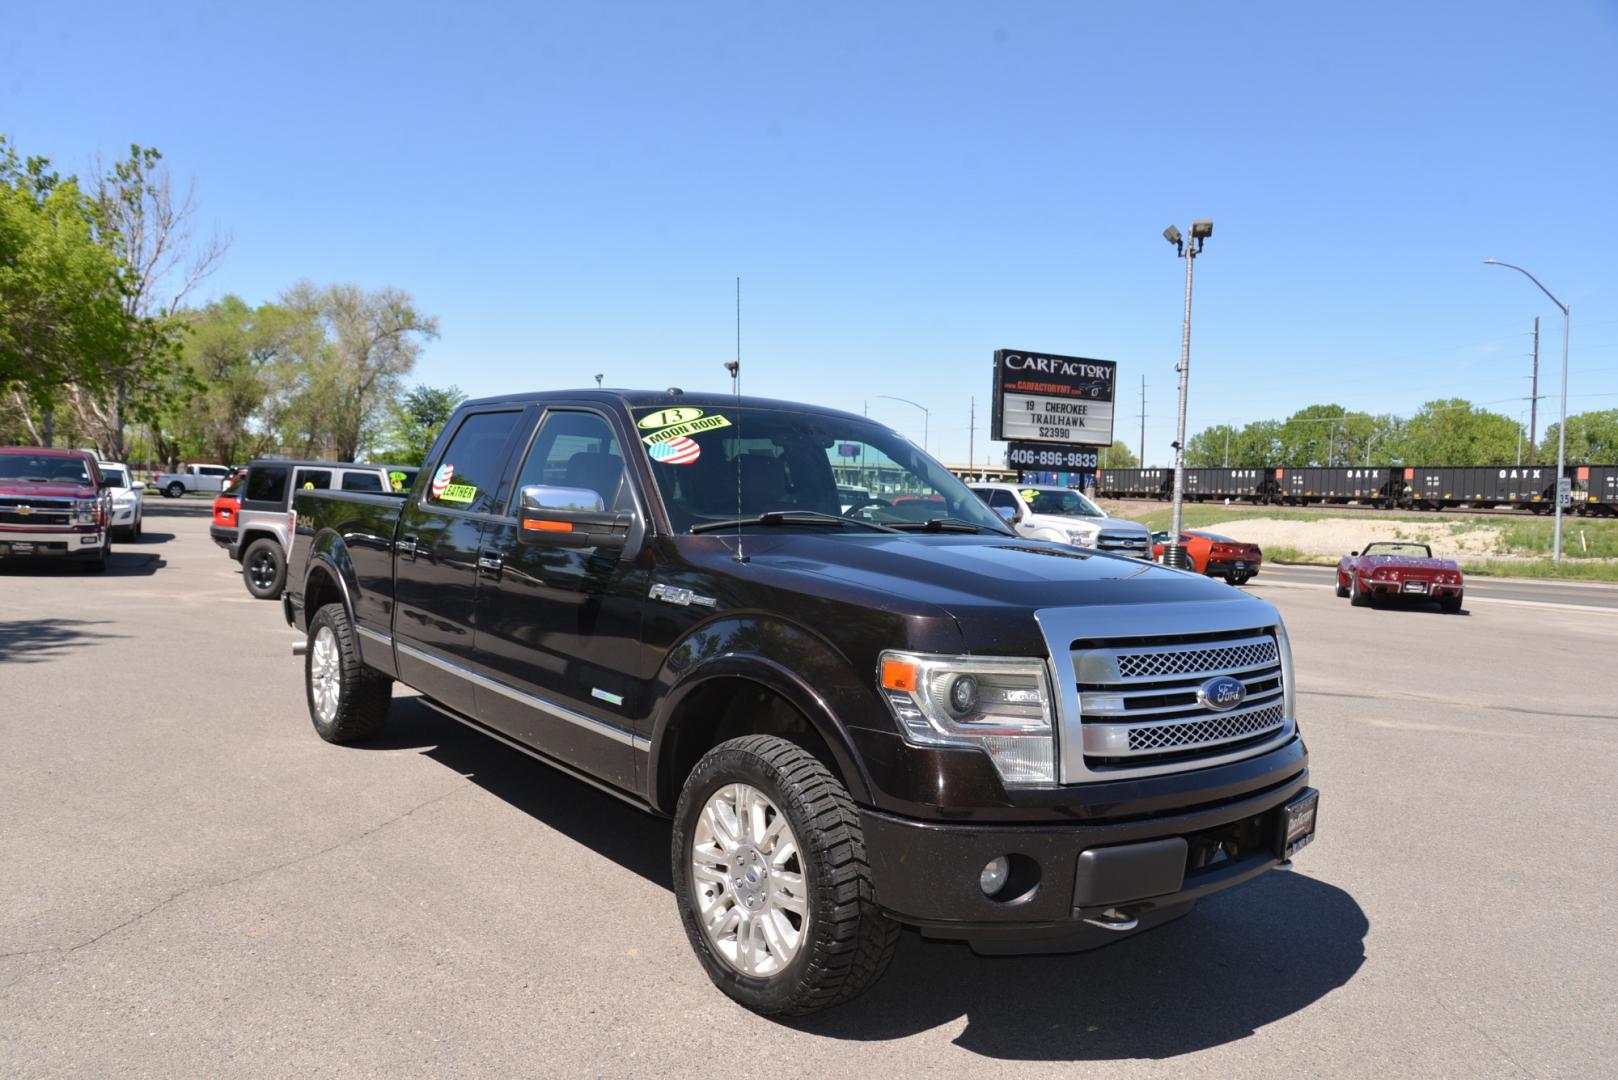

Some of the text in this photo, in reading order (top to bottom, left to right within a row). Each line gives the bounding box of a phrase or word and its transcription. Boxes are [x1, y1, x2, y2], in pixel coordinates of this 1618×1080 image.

[1045, 402, 1088, 415] CHEROKEE
[1031, 413, 1086, 427] TRAILHAWK
[649, 417, 723, 444] MOON ROOF
[1039, 427, 1070, 439] $23990
[1010, 449, 1097, 467] 406-896-9833
[1217, 683, 1240, 702] Ford
